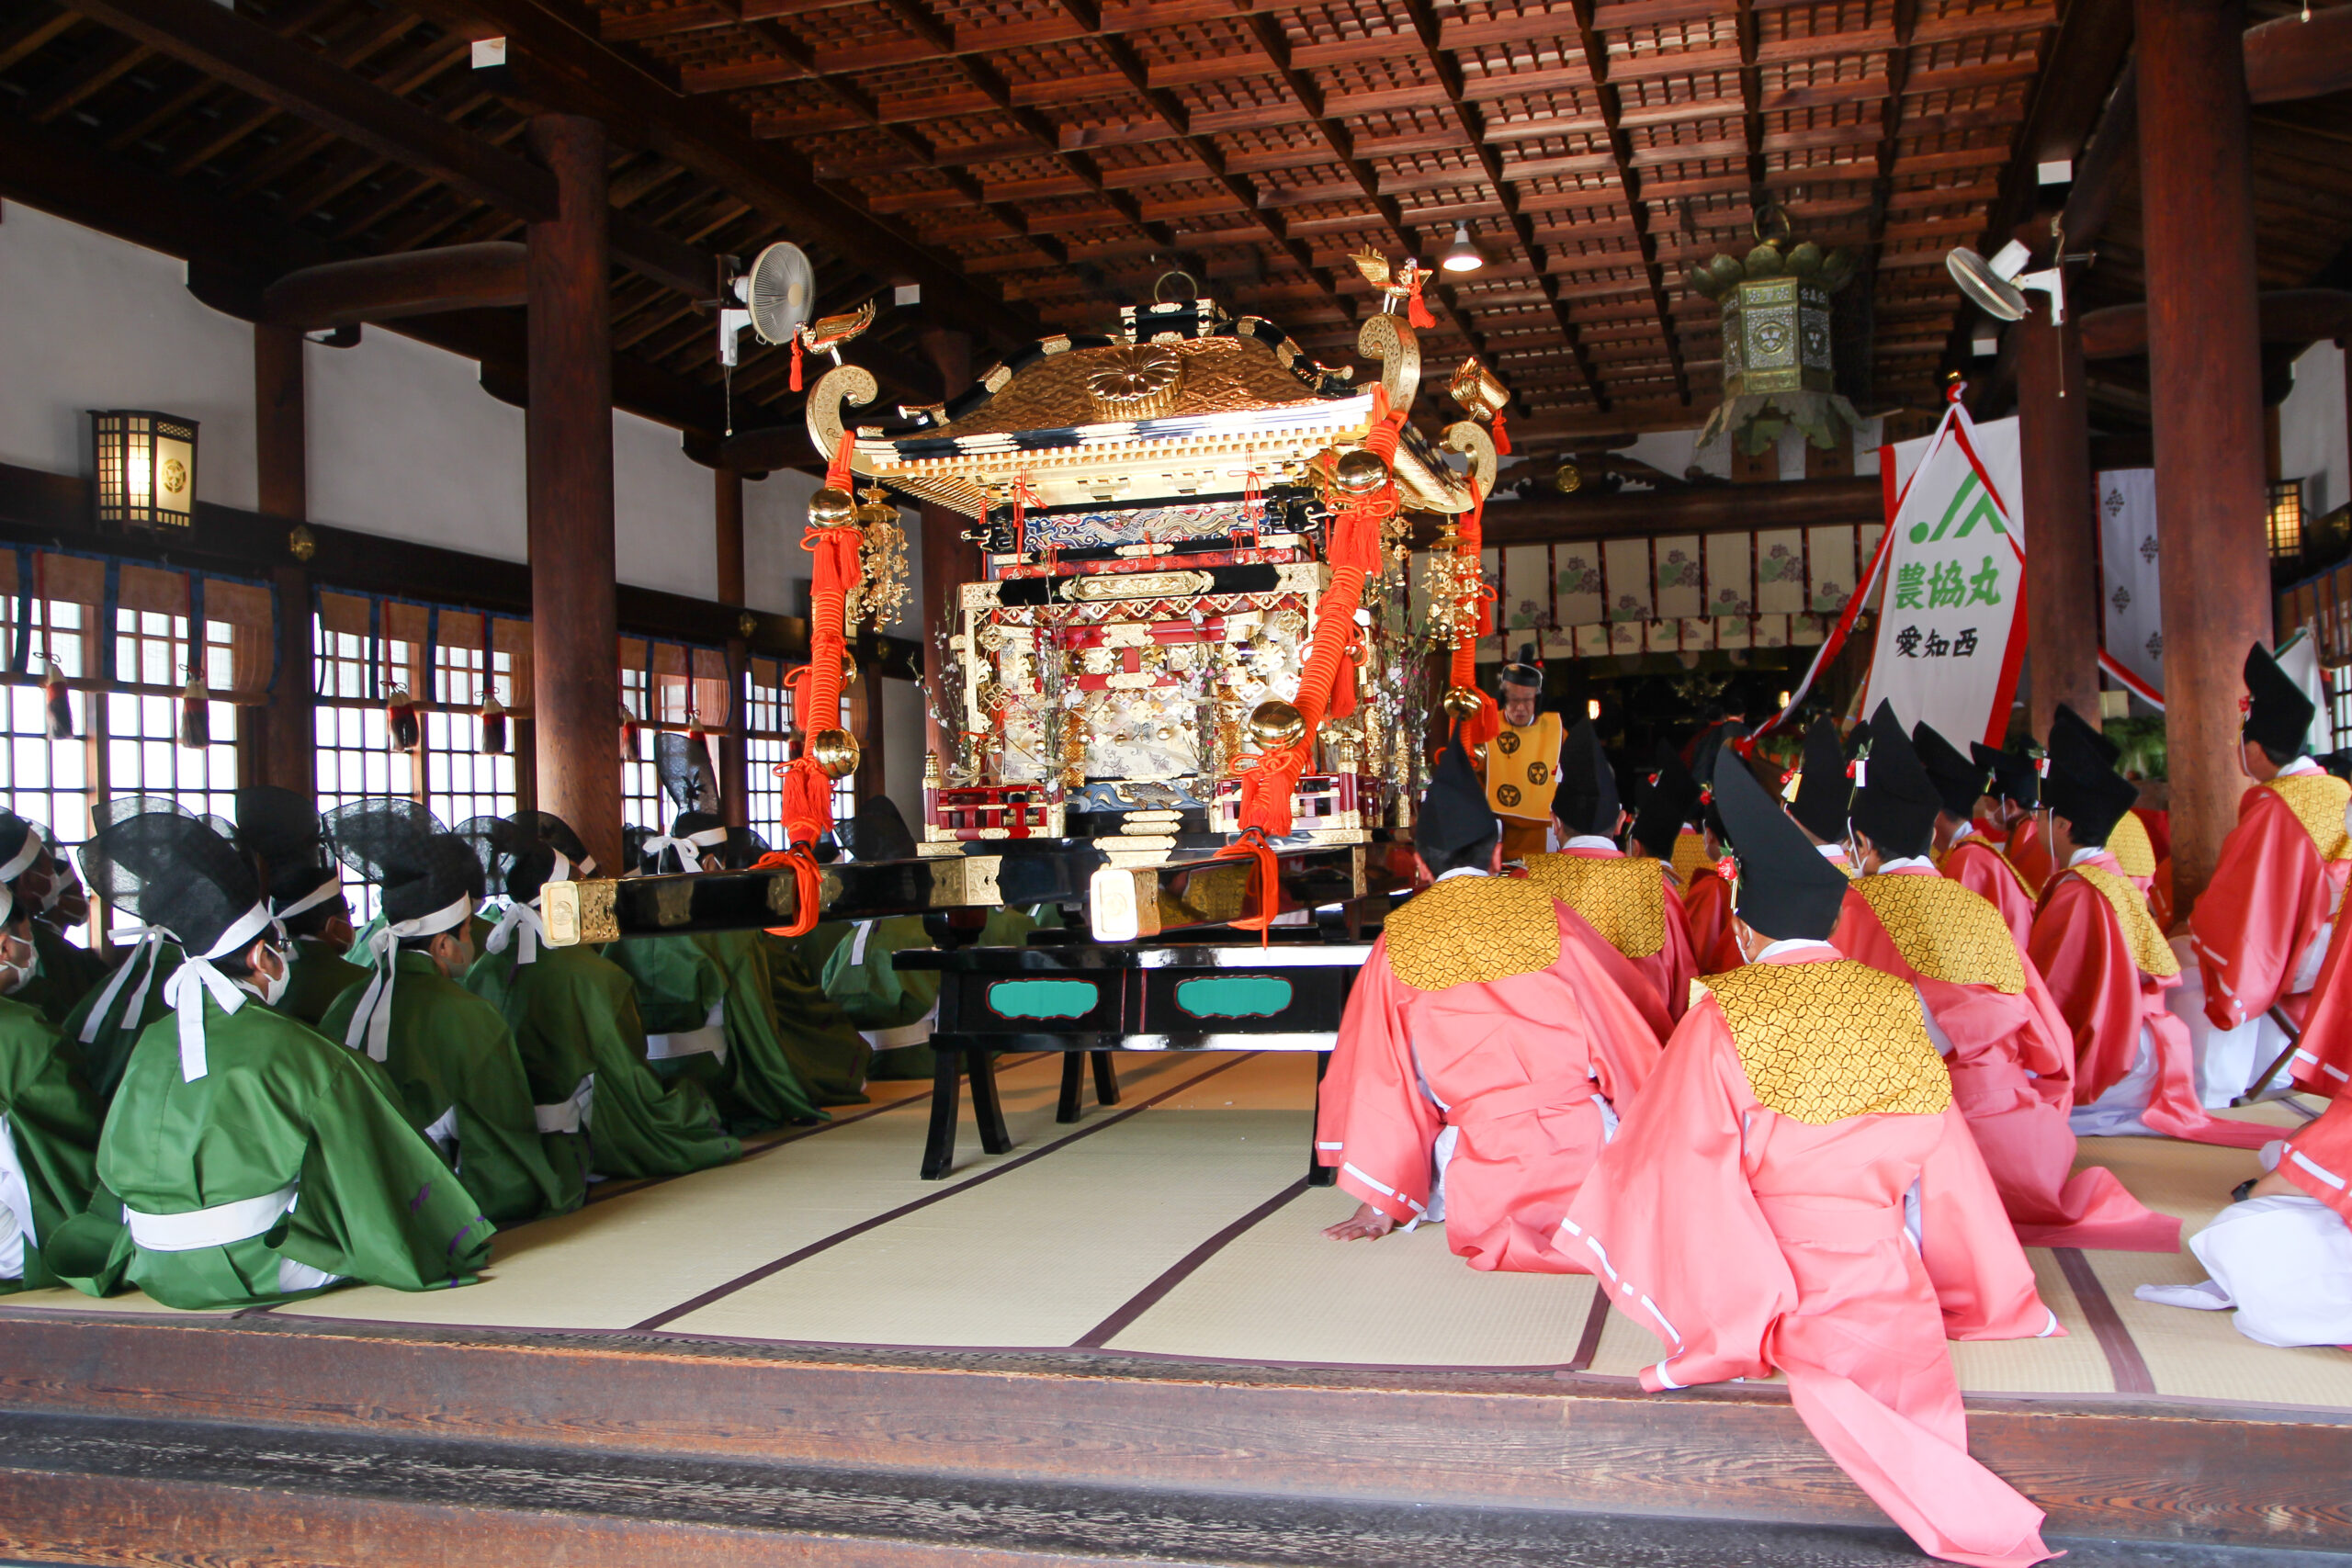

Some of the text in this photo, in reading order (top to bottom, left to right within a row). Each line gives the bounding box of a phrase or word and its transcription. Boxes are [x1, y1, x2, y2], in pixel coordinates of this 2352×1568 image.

[1895, 556, 2001, 610] 農協丸
[1895, 625, 1979, 659] 愛知西
